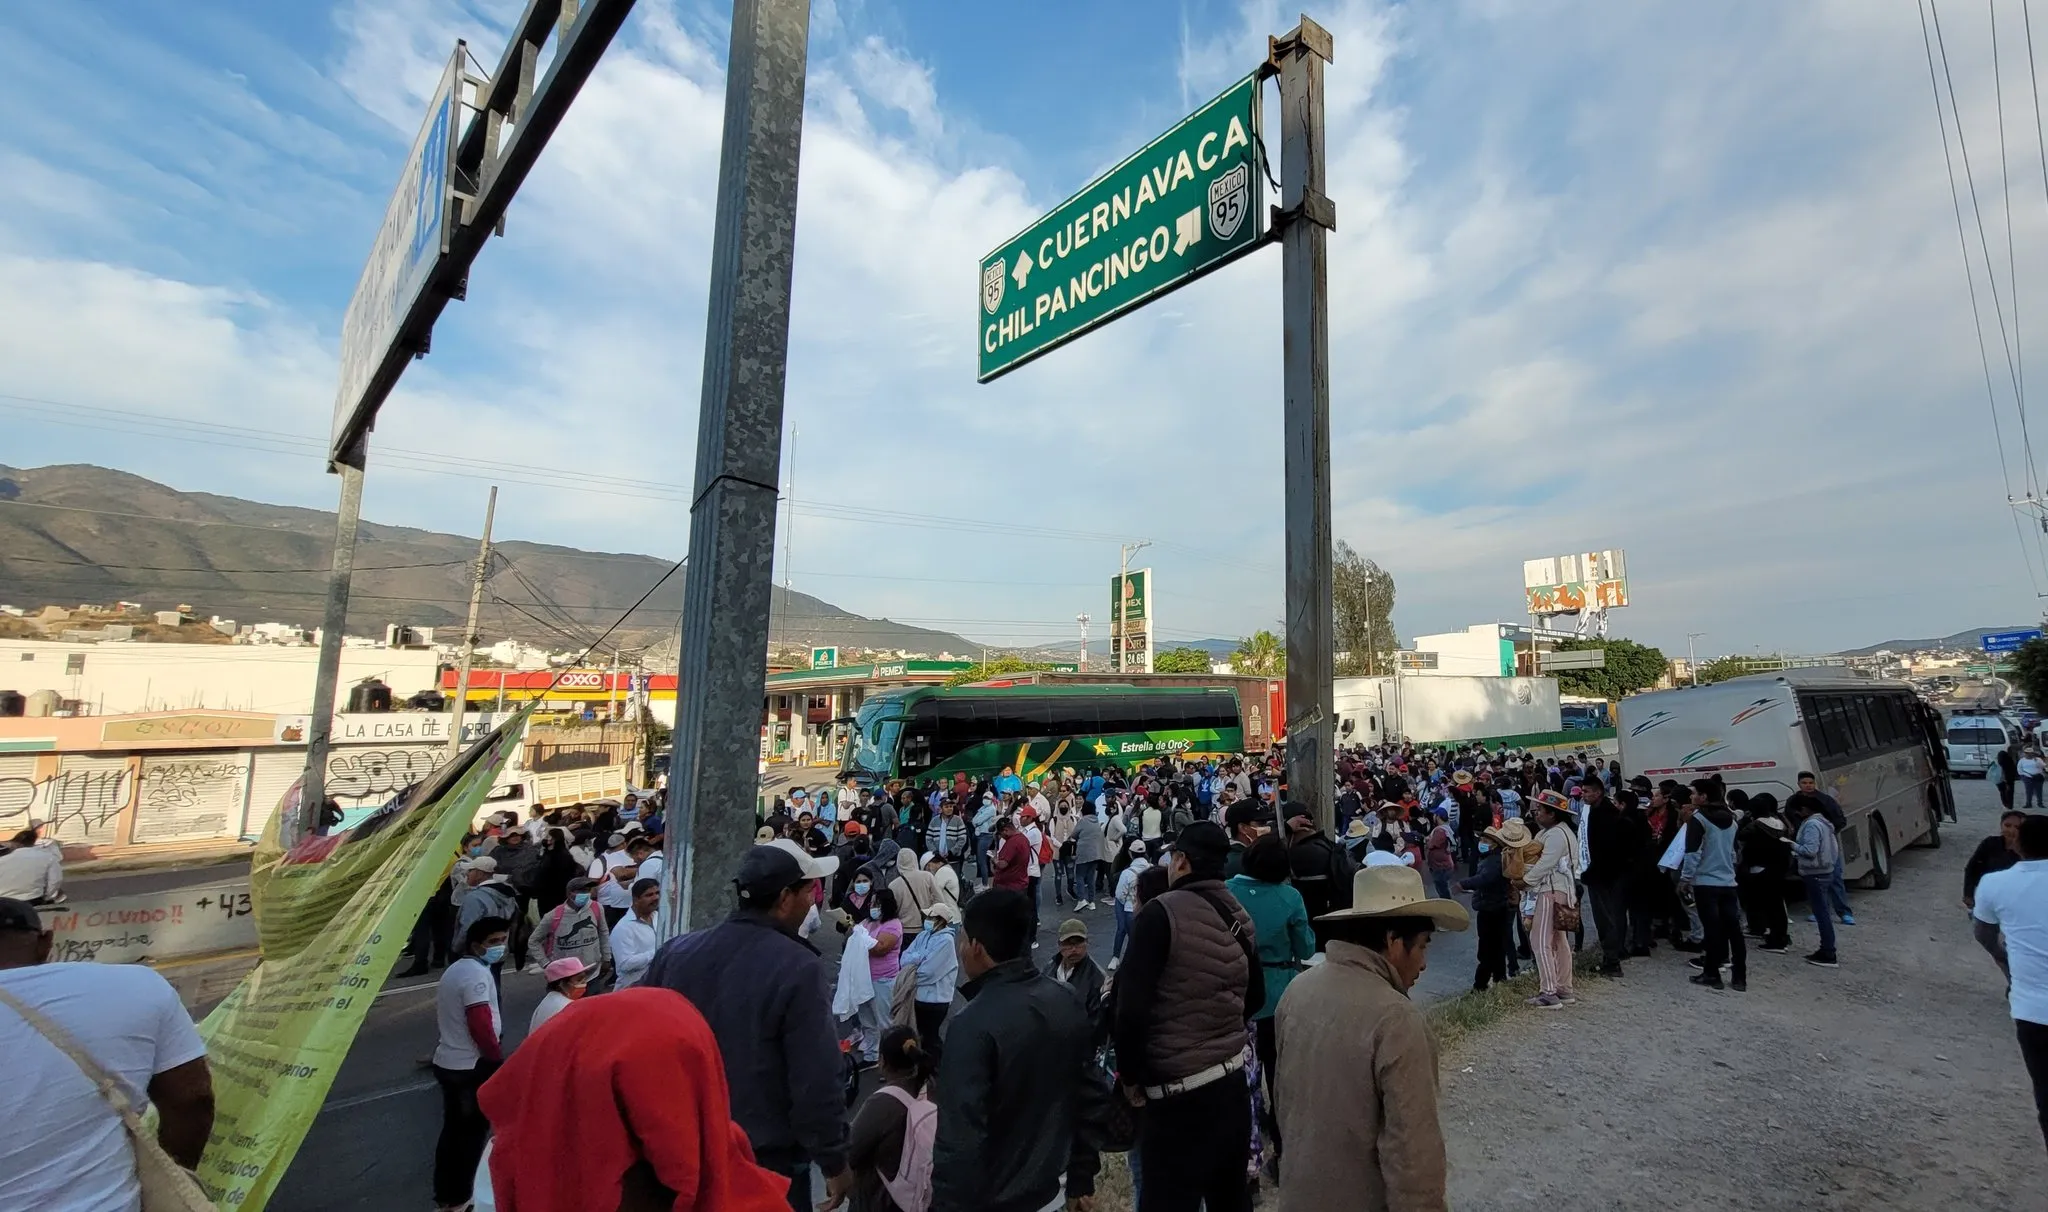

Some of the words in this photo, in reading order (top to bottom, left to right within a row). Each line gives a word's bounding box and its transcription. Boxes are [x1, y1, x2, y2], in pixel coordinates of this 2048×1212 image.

[1039, 115, 1248, 269] CUERNAVACA
[1214, 173, 1241, 199] MEXICO
[1217, 193, 1238, 226] 95
[985, 226, 1169, 353] CHILPANCINGO
[988, 281, 999, 304] 95
[1115, 598, 1141, 609] PMEX
[560, 674, 600, 685] OXXO
[880, 665, 903, 676] PEMEX
[345, 724, 366, 738] LA
[374, 724, 413, 737] CASA
[1121, 741, 1153, 753] Estrella
[1155, 740, 1166, 751] de
[1168, 739, 1183, 749] Oro
